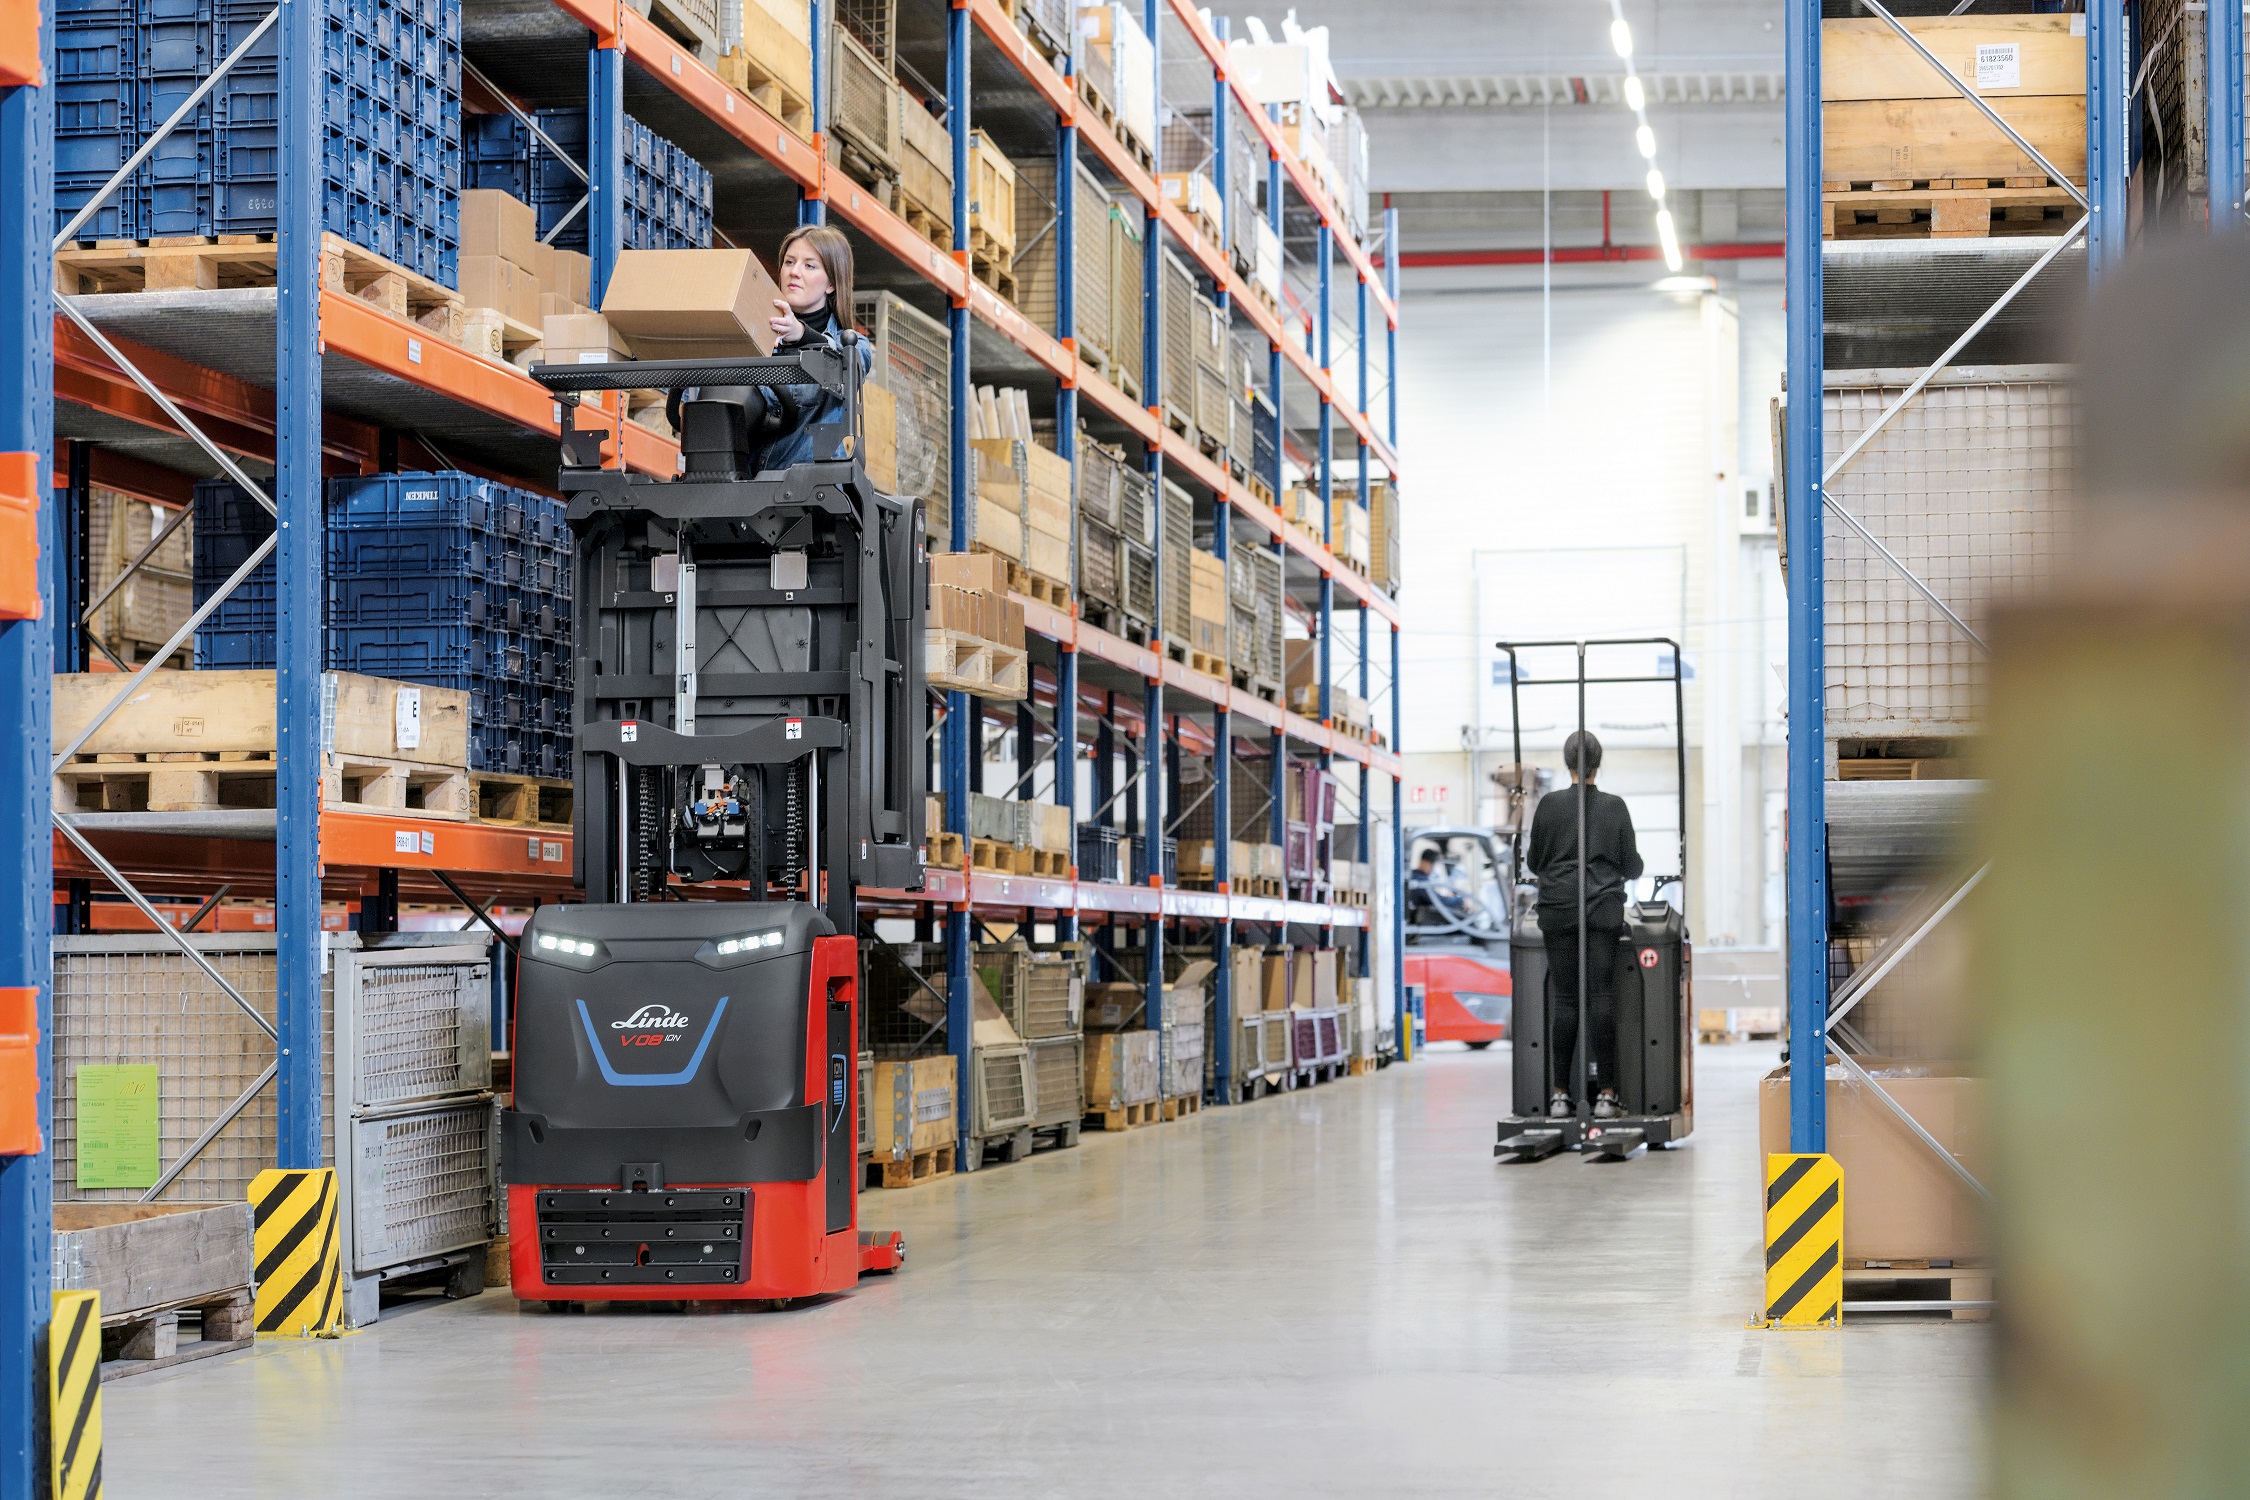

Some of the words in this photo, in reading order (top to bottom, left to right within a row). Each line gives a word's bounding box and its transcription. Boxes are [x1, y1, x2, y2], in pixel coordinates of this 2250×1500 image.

[1980, 54, 2014, 62] 61823560
[405, 491, 439, 501] TIMKEN
[412, 701, 417, 718] E
[611, 1004, 689, 1029] Linde
[664, 1034, 682, 1042] ION
[833, 1062, 843, 1075] ION
